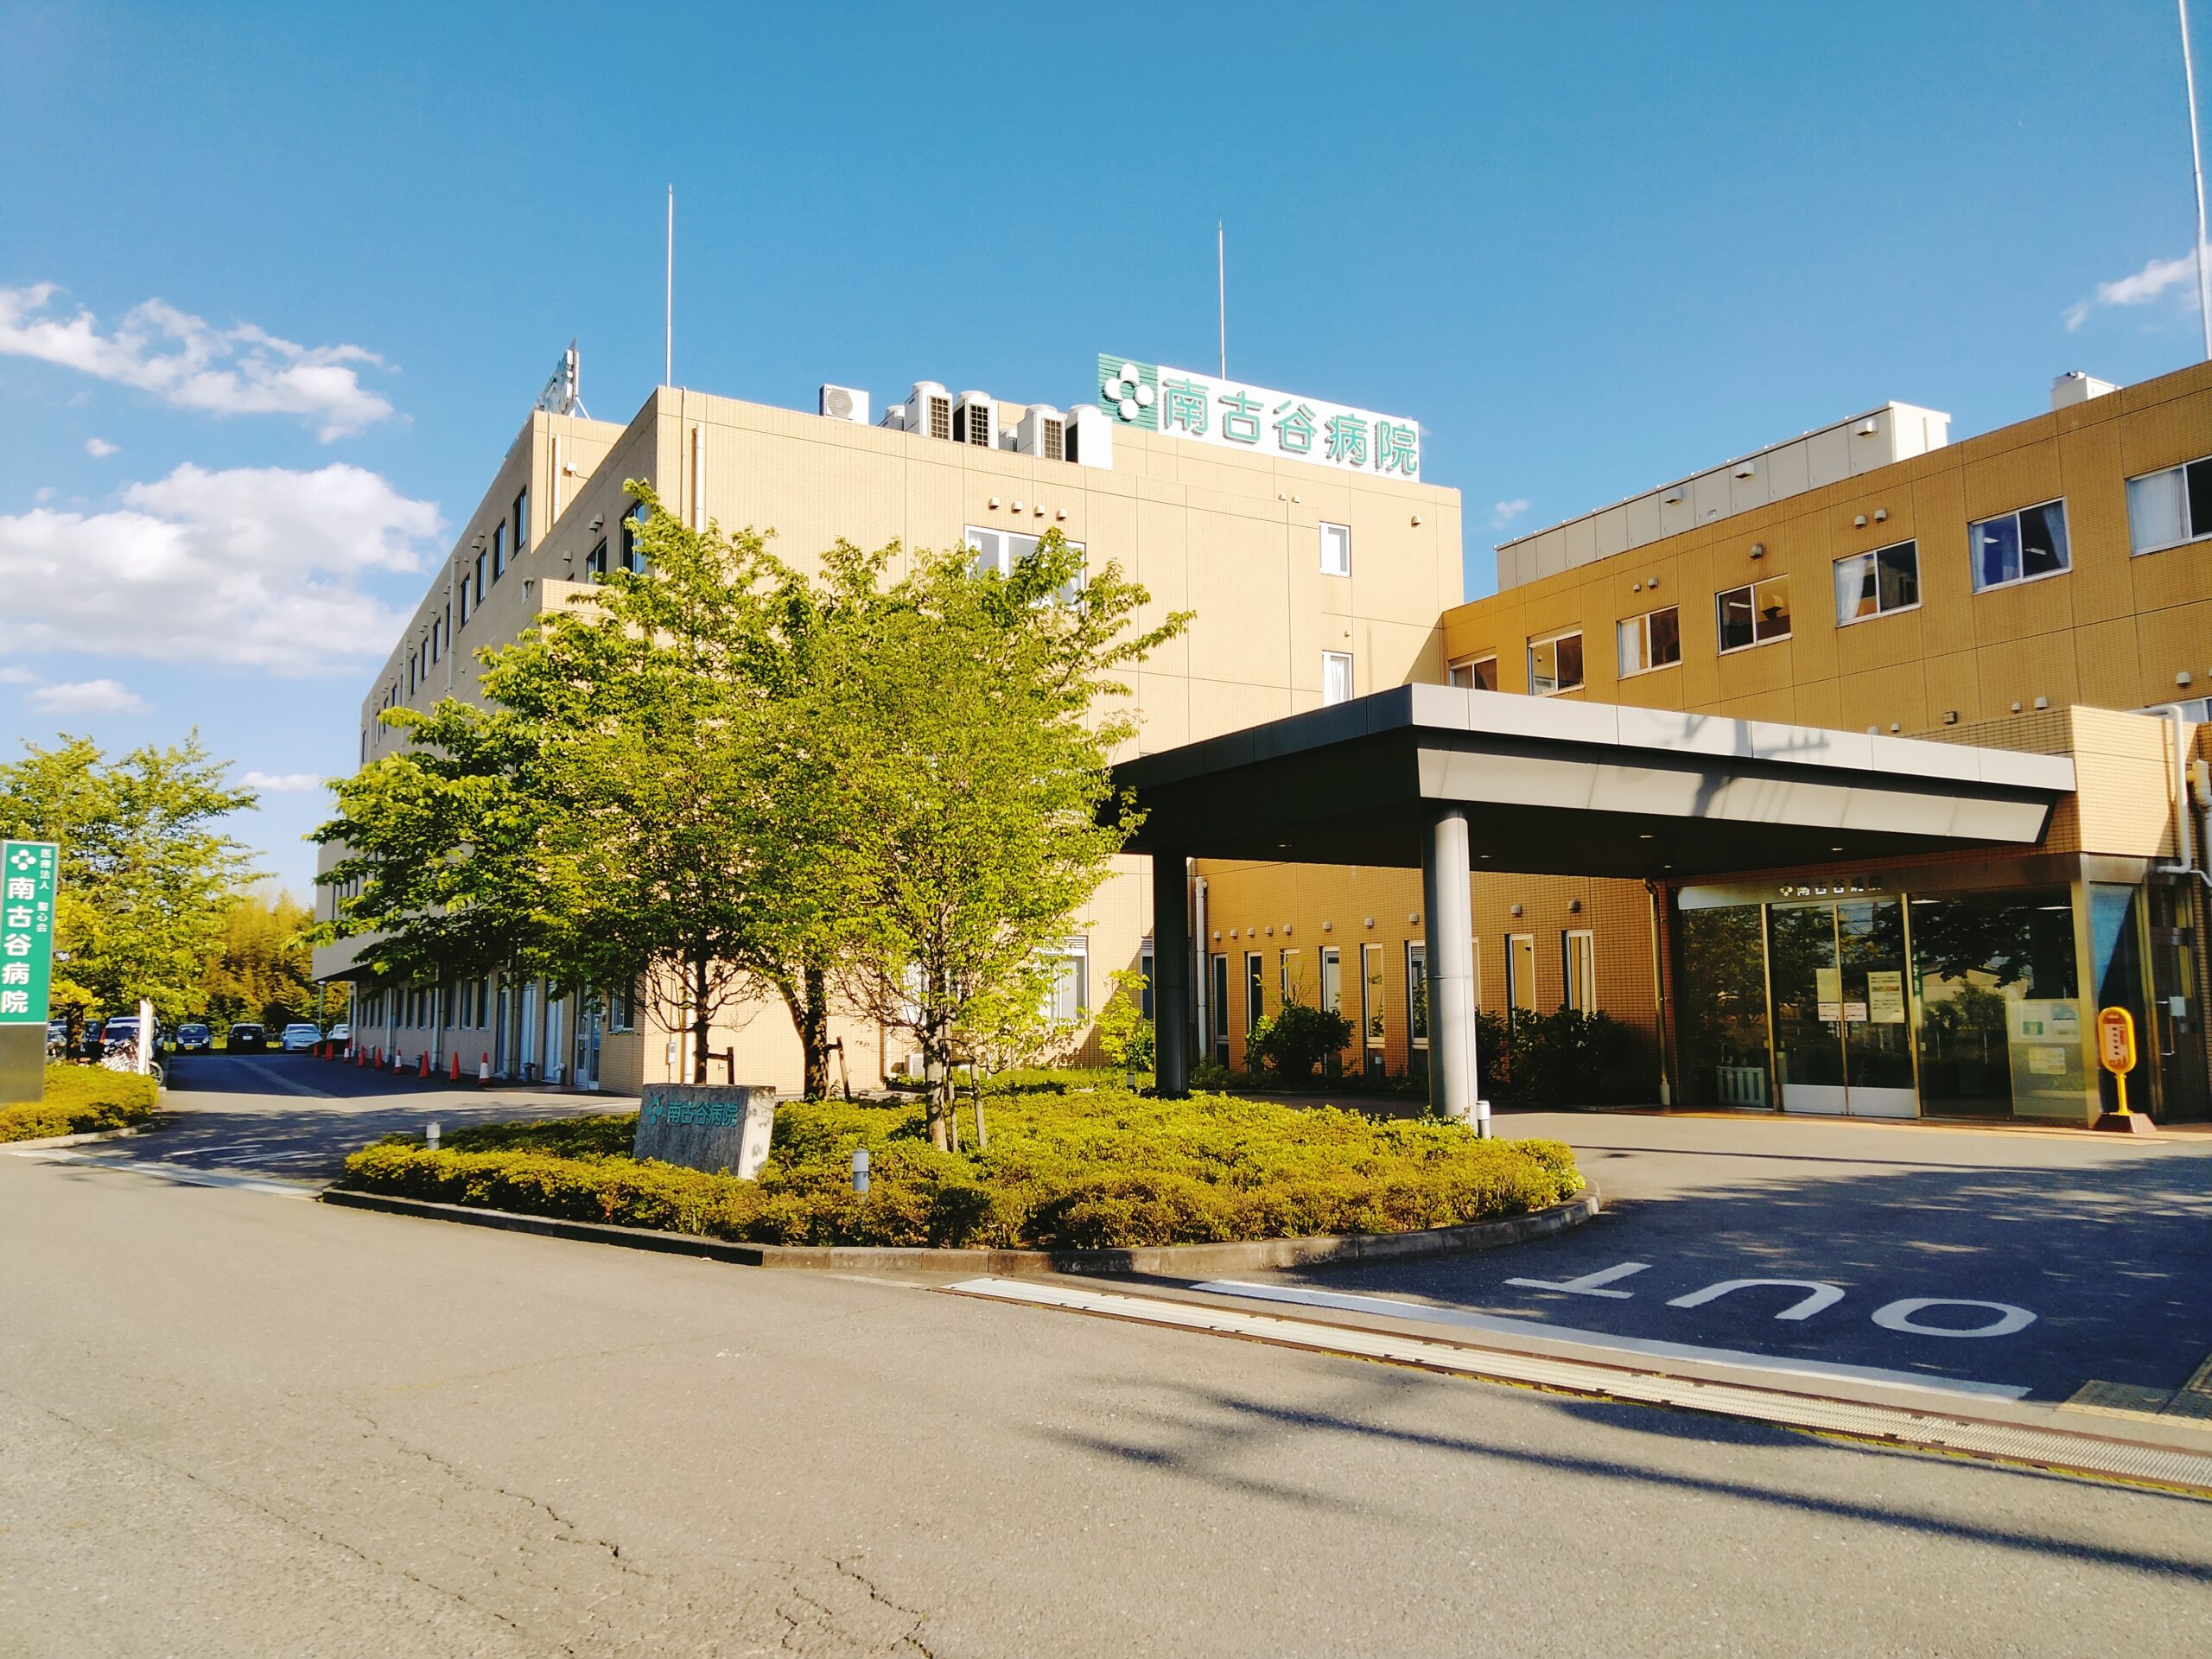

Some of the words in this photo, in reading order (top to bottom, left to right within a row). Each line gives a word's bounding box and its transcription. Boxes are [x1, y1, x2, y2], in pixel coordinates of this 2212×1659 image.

[1163, 378, 1418, 475] 南古谷病院
[39, 849, 54, 890] 医療法人
[0, 876, 36, 1014] 南古谷病院
[35, 901, 50, 933] 聖心会
[666, 1100, 740, 1128] 南古谷病院
[1503, 1262, 2038, 1338] OUT
